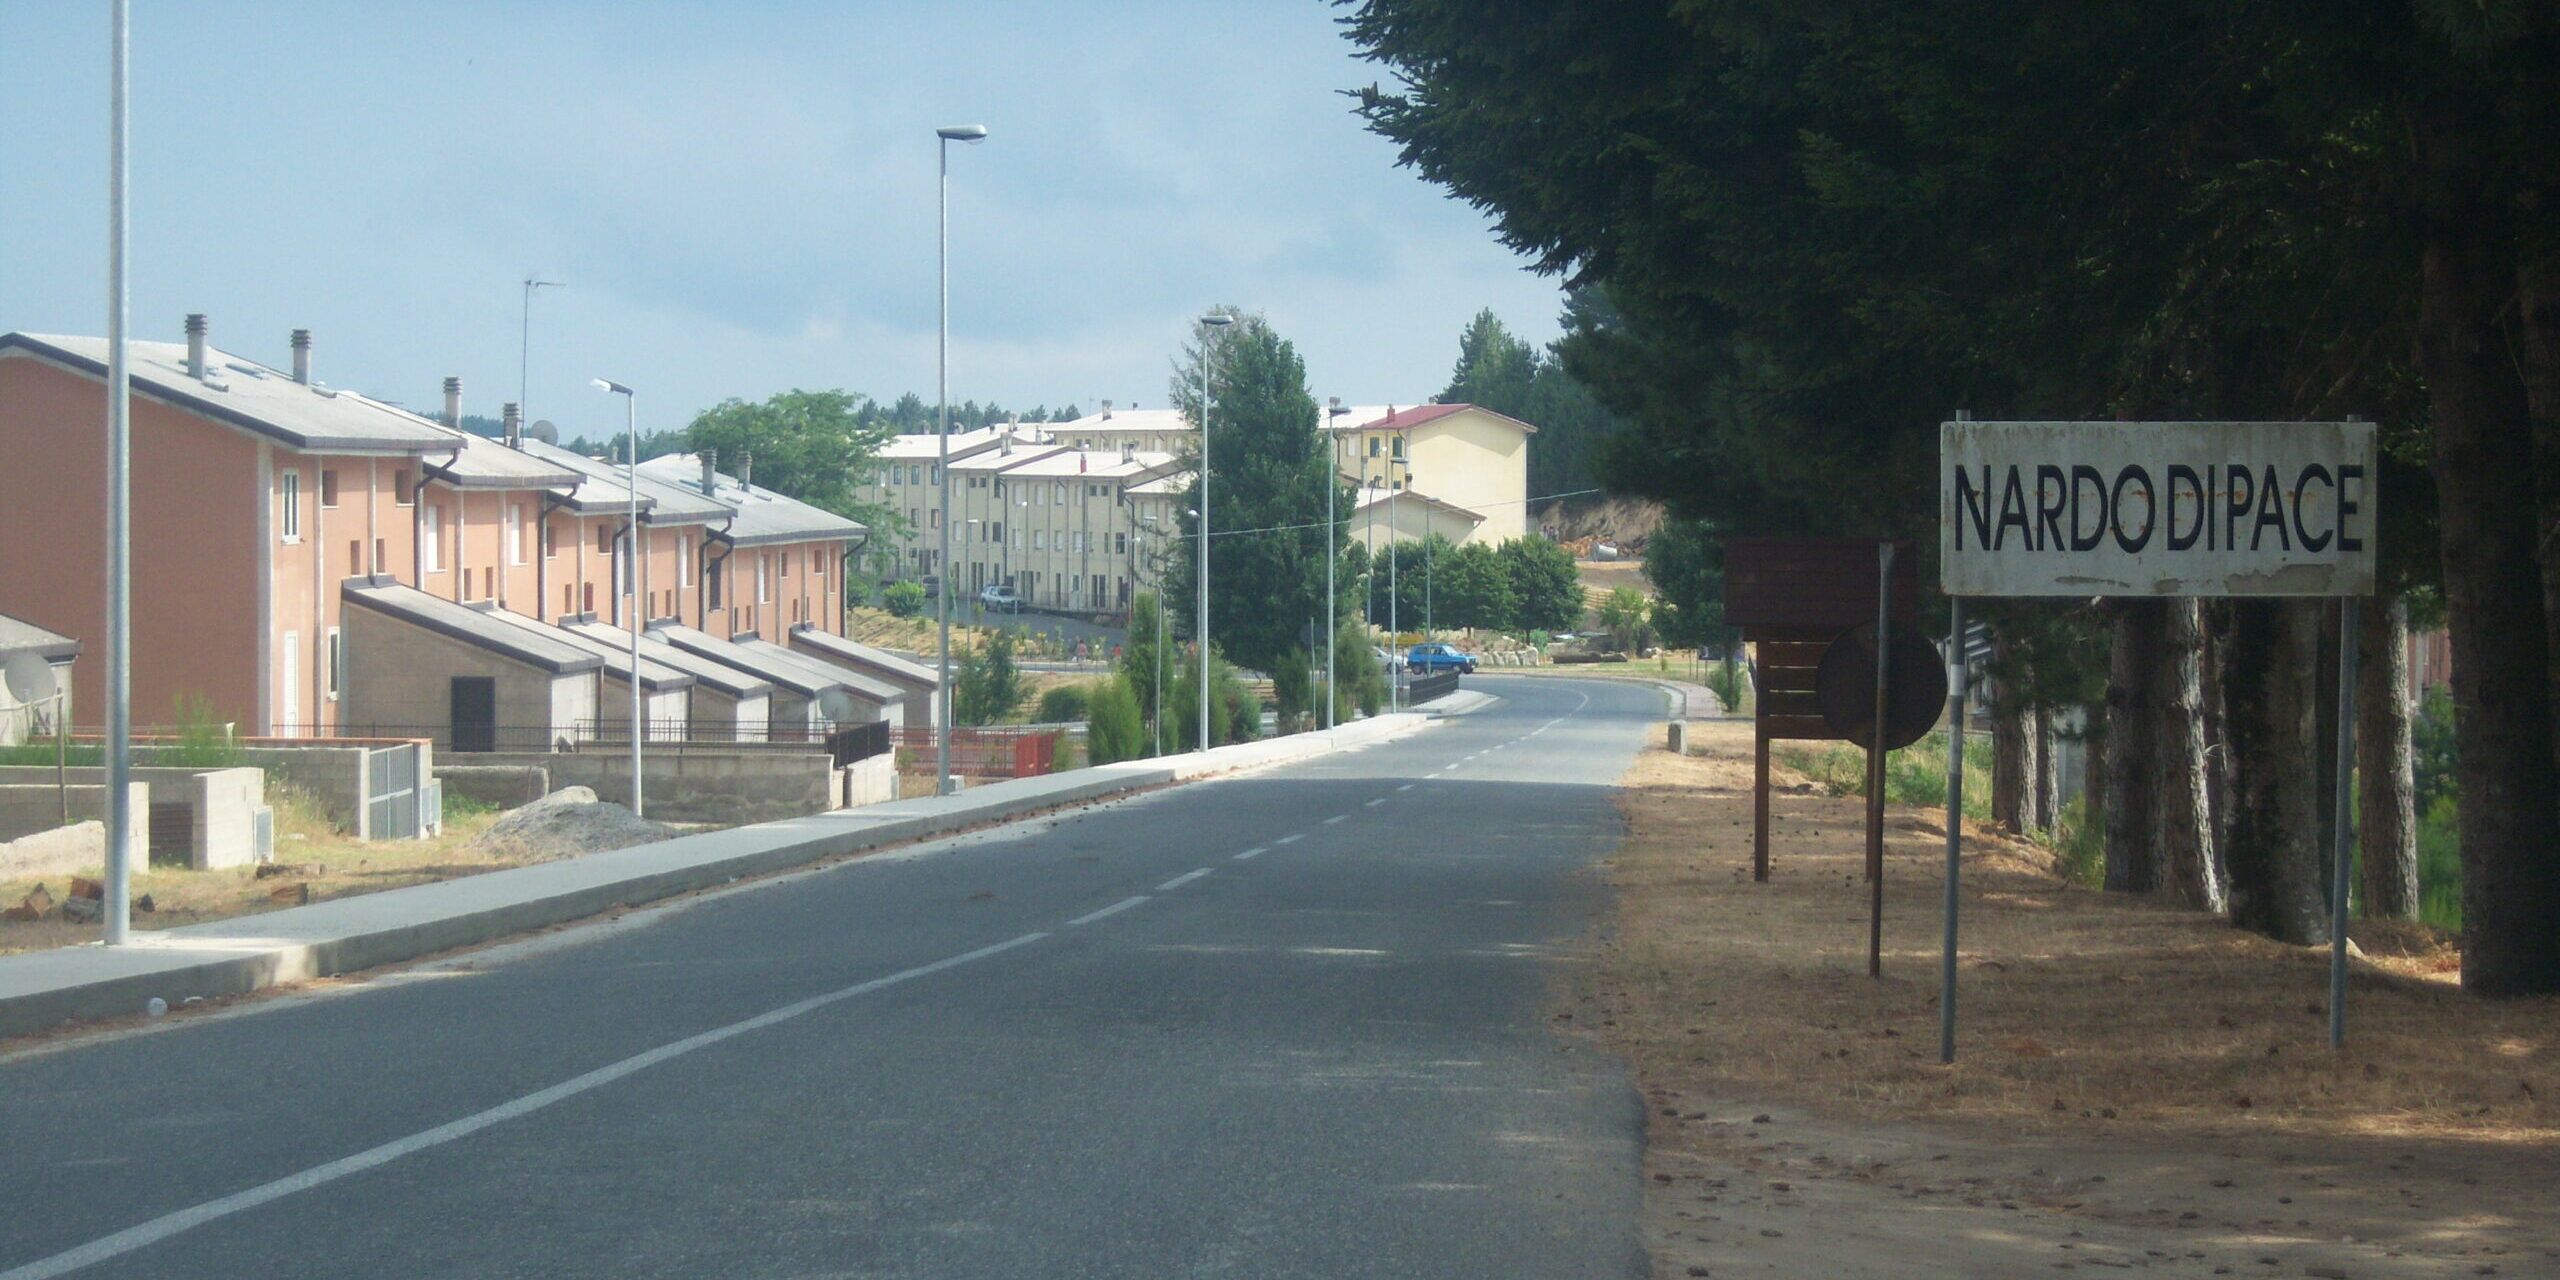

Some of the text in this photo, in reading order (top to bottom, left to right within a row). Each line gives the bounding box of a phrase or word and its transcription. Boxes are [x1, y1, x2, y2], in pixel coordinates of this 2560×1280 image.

[1954, 463, 2364, 554] NARDO DI PACE
